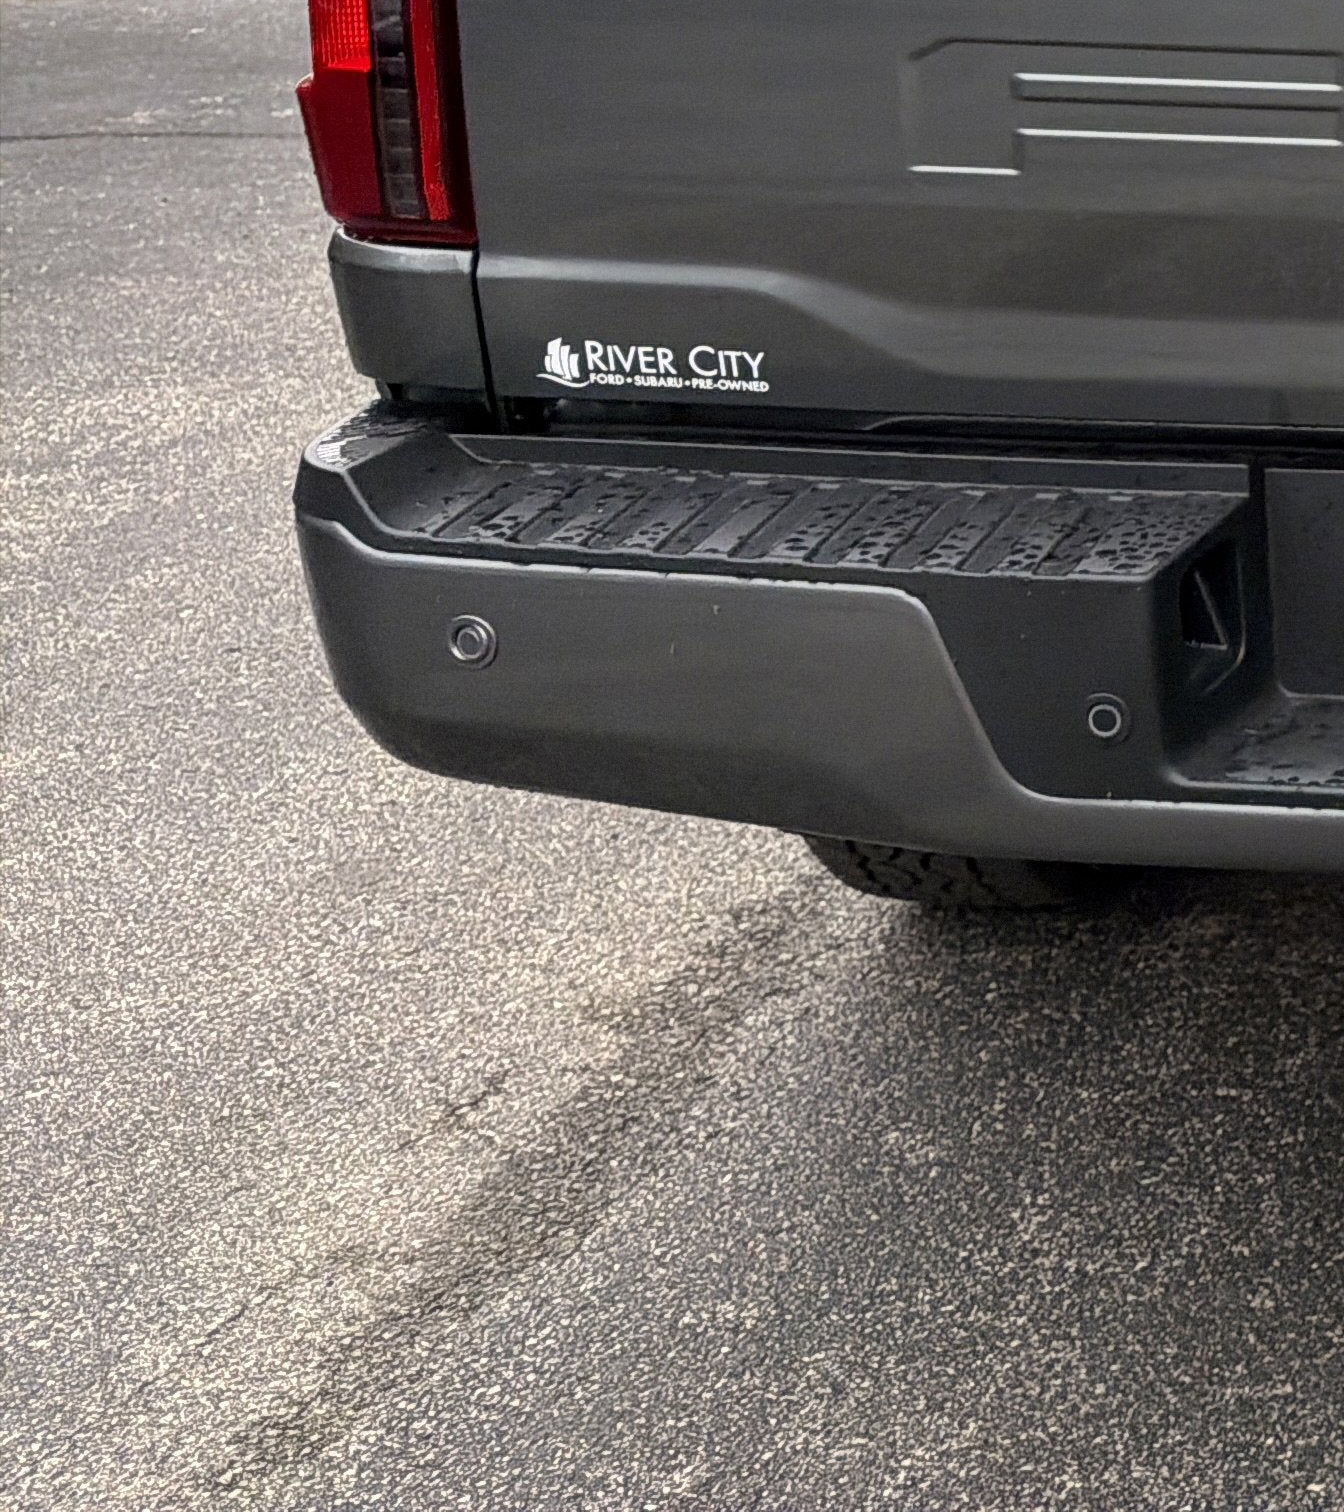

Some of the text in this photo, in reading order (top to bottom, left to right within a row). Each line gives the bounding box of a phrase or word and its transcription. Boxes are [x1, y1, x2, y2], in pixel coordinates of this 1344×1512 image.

[584, 339, 765, 379] RIVER CITY
[589, 372, 770, 393] FORD SUBARU PRE-OWNED
